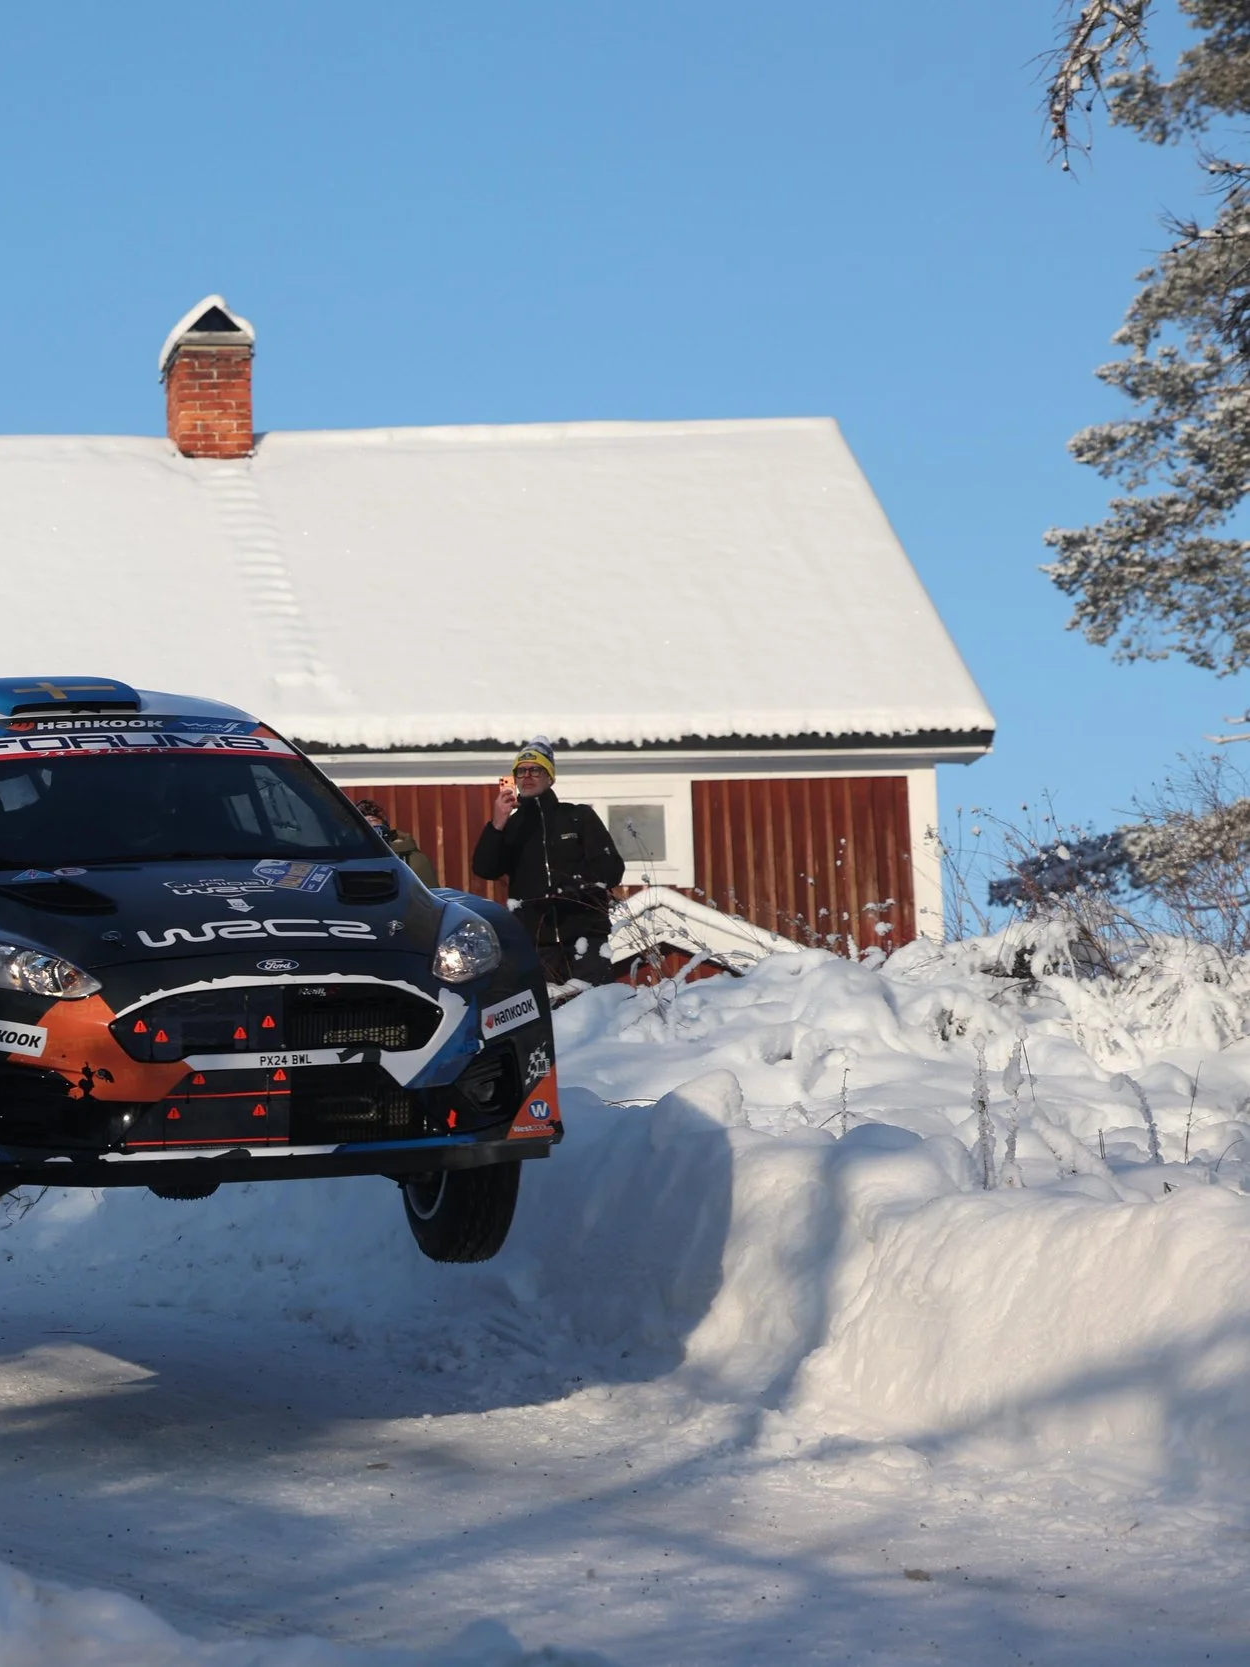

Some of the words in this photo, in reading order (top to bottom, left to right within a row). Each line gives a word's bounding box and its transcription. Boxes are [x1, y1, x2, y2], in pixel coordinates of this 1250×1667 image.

[136, 918, 378, 949] WRC2
[264, 960, 292, 970] Ford
[260, 1055, 288, 1067] PX24
[291, 1053, 313, 1065] BWL
